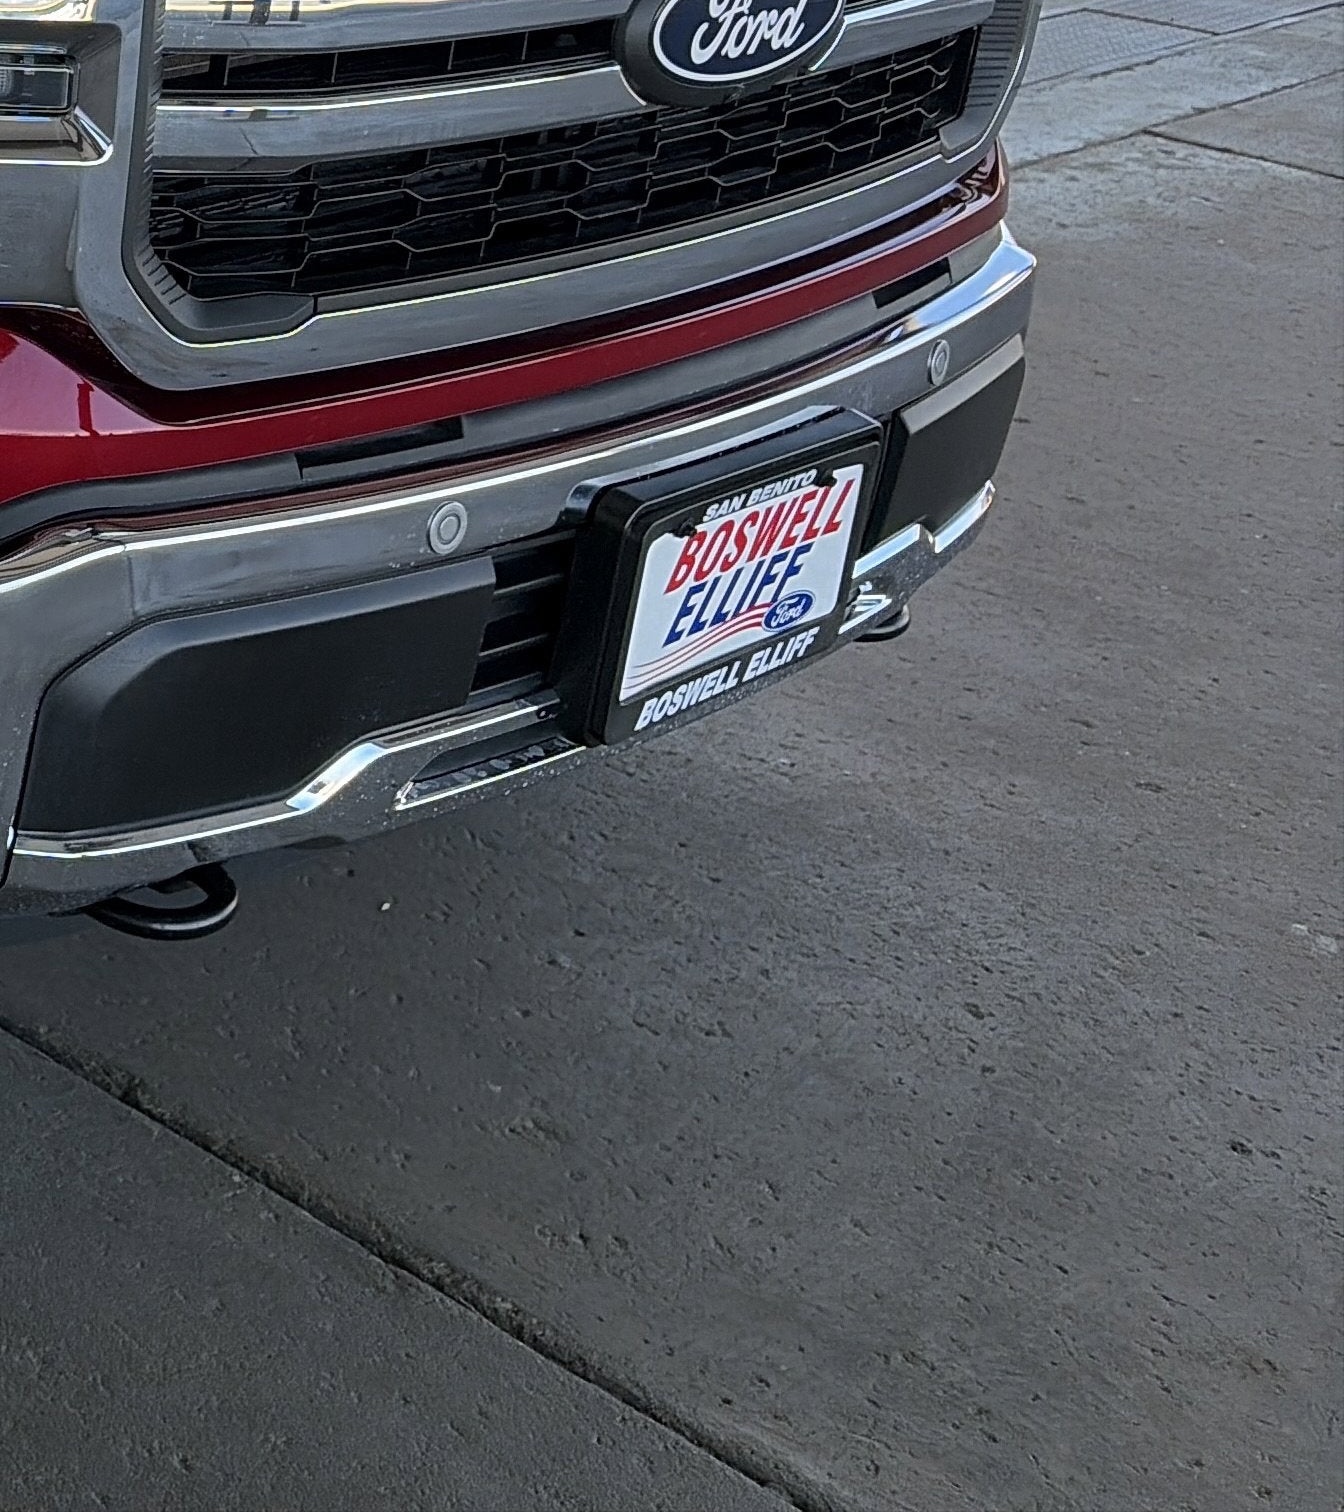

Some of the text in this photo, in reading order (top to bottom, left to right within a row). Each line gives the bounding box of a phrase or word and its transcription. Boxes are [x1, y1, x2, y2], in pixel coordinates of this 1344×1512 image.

[664, 479, 855, 595] BOSWELL
[702, 469, 817, 522] SAN BENITO
[662, 542, 814, 648] ELLIFF
[768, 595, 809, 629] Ford
[634, 626, 820, 732] BOSWELL ELLIFF
